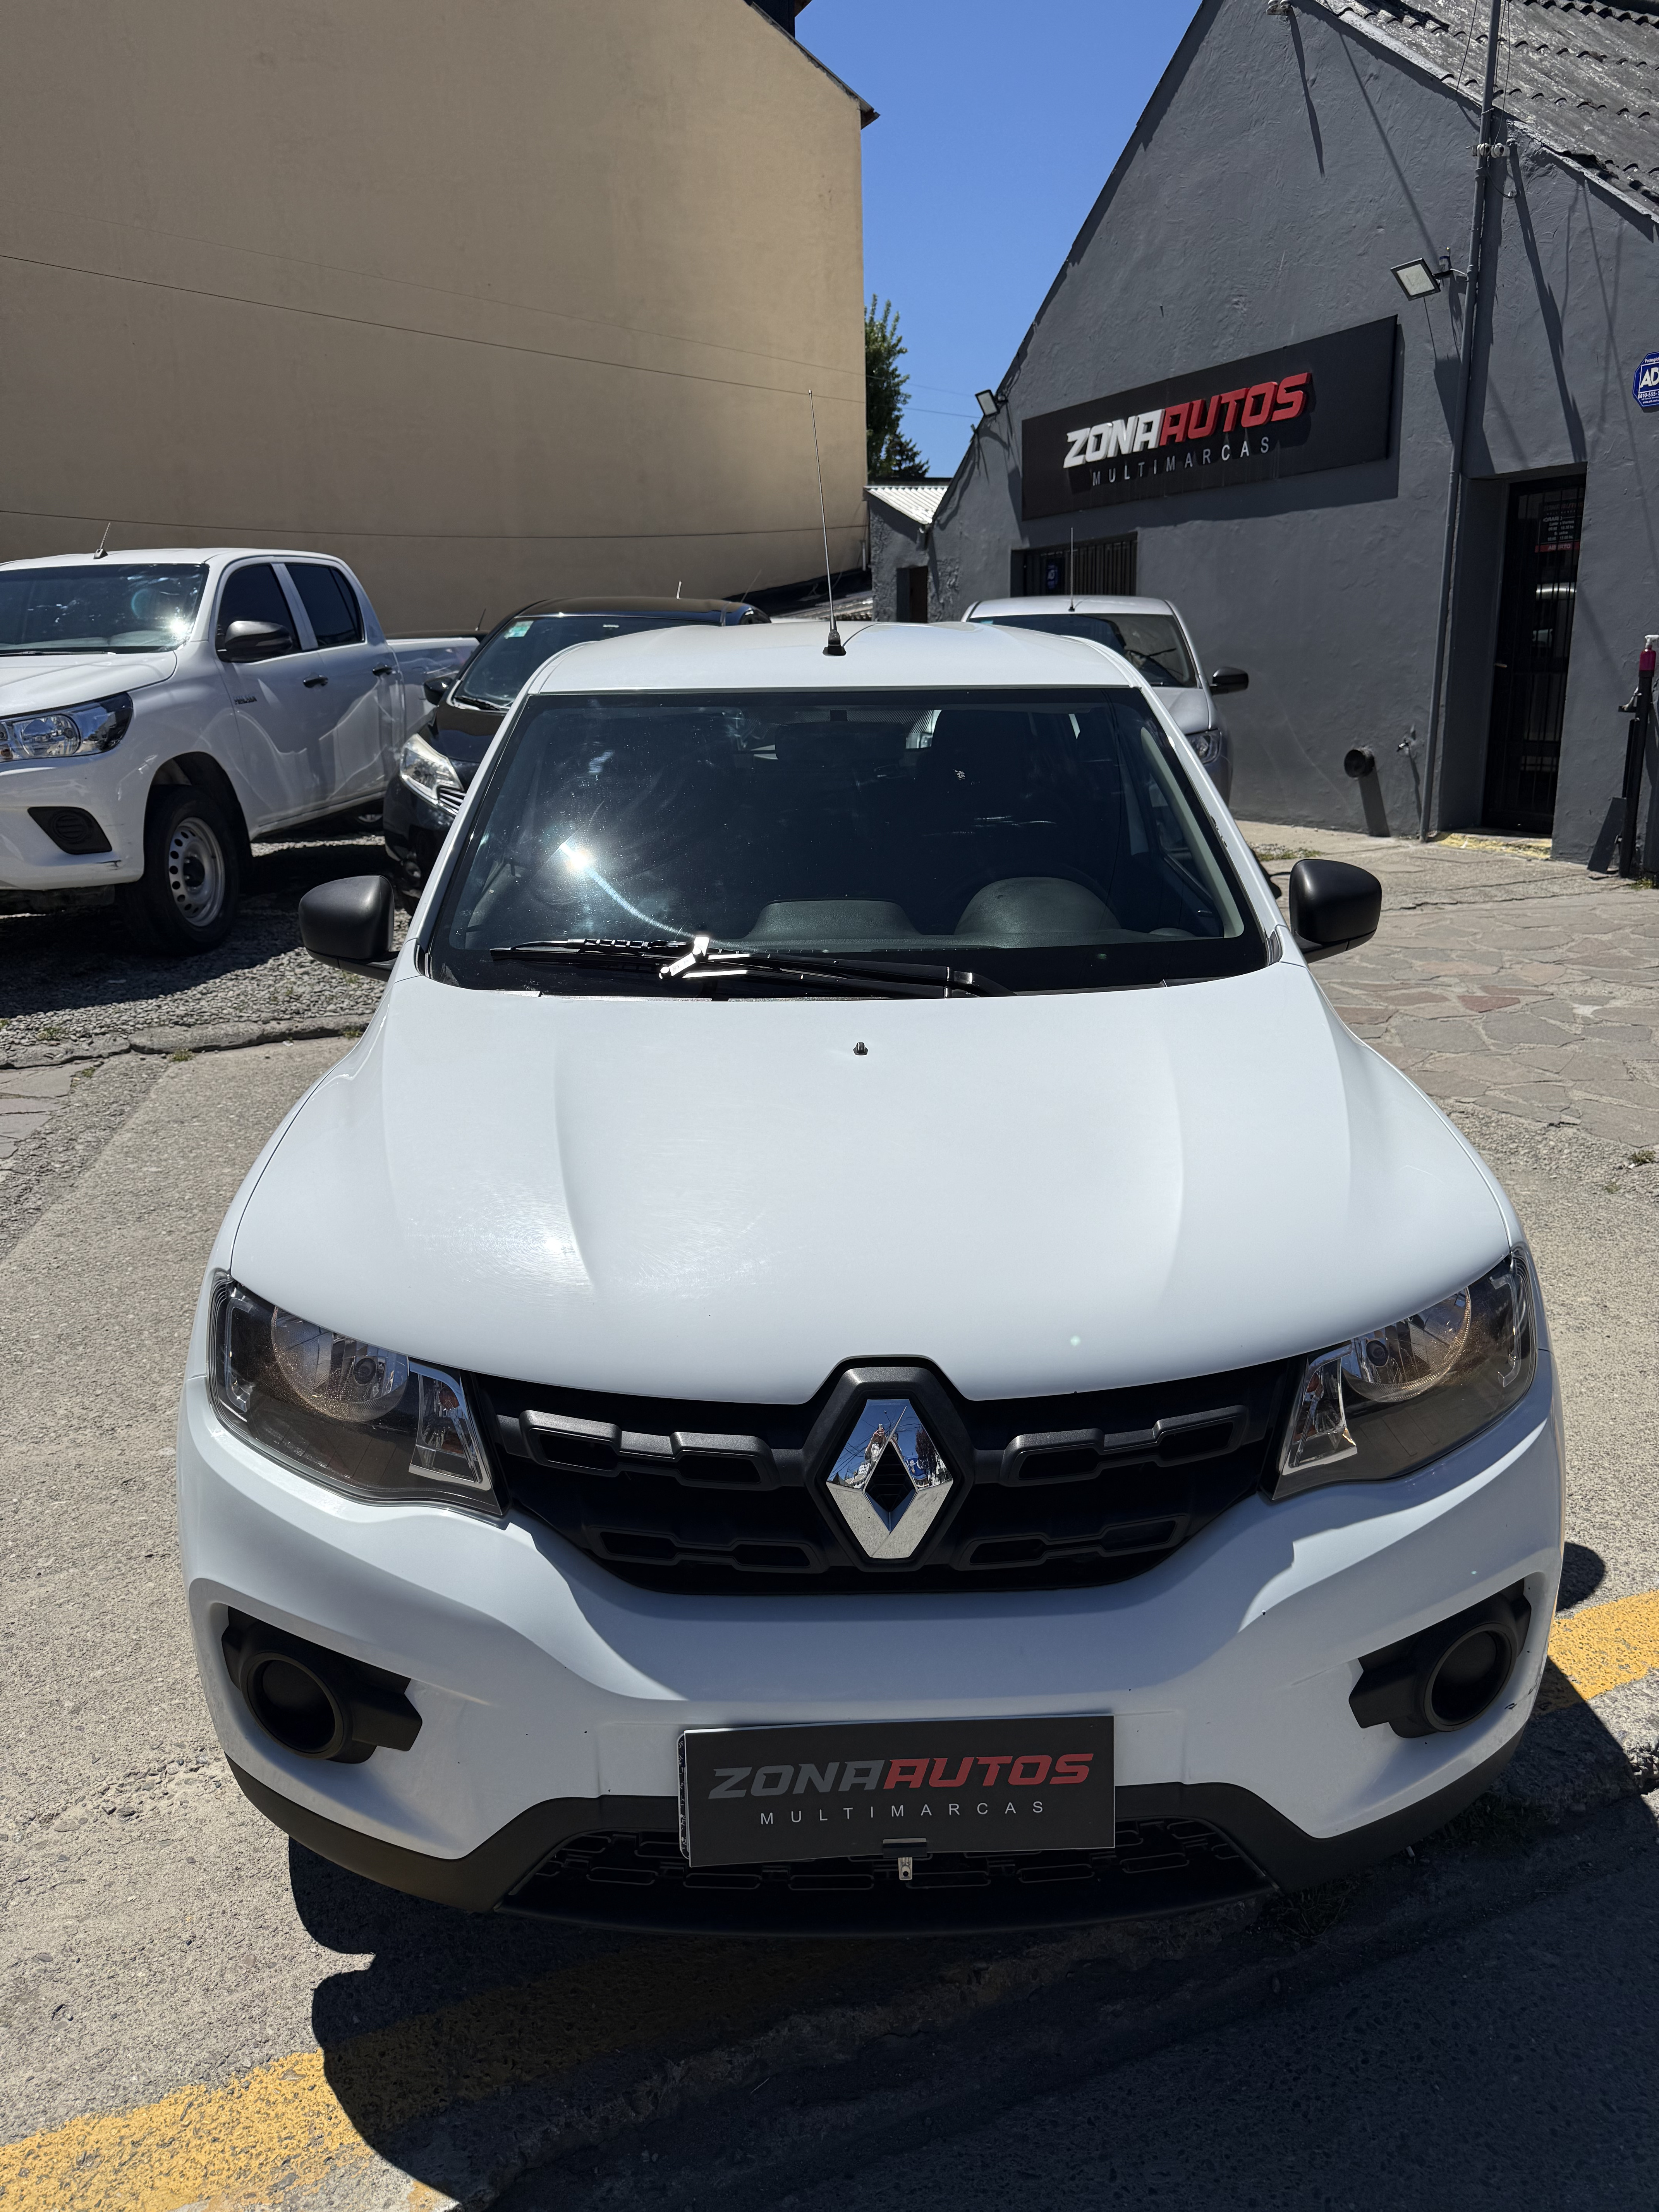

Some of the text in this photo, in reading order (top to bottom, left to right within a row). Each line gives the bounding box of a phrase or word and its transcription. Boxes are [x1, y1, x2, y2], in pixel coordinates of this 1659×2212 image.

[1640, 367, 1659, 388] AD
[1092, 436, 1271, 486] MULTIMARCAS
[761, 1801, 1044, 1825] MULTIMARCAS
